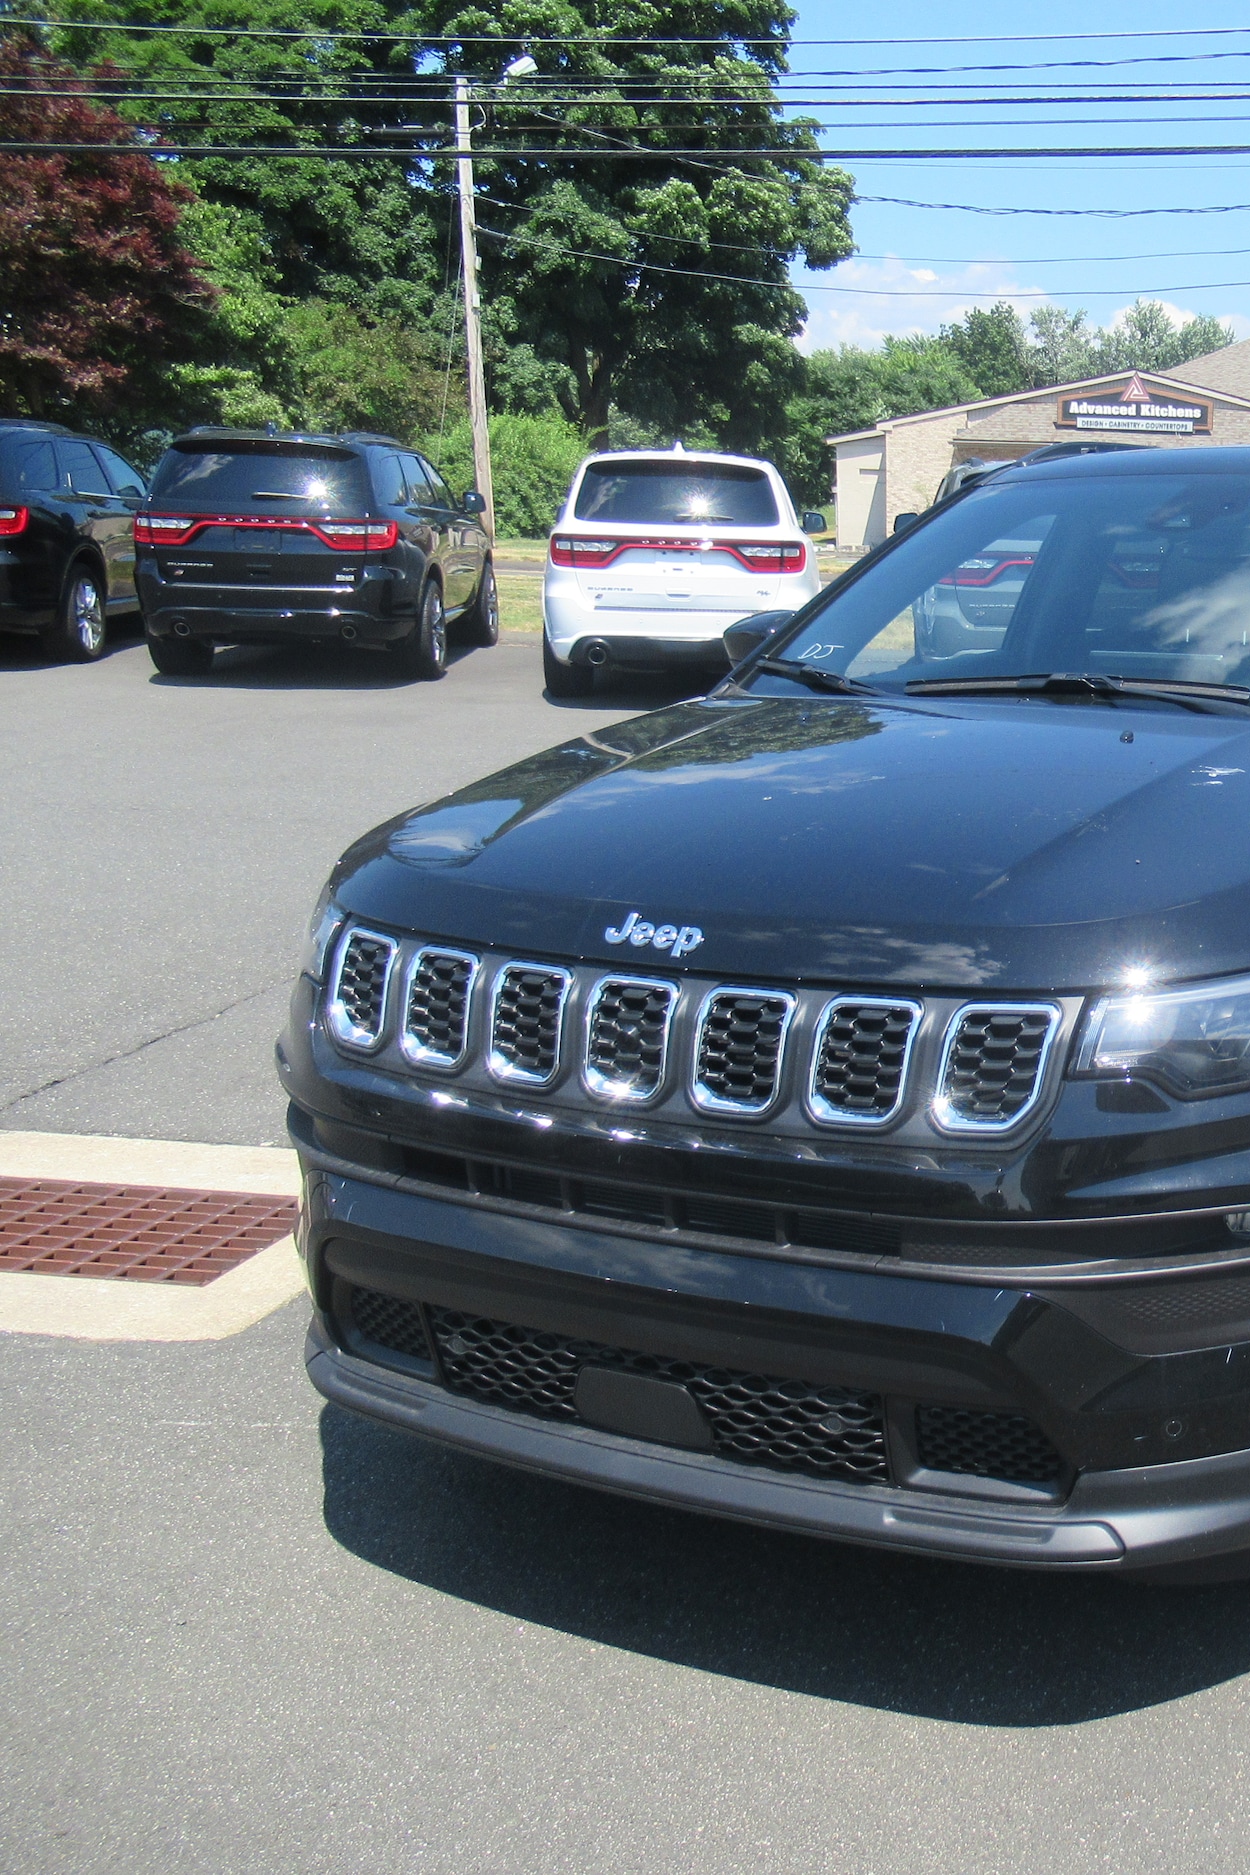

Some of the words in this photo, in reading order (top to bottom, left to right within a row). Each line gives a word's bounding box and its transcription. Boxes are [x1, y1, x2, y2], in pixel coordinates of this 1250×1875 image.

[1069, 401, 1137, 416] Advanced
[1140, 403, 1202, 419] Kitchens
[1081, 420, 1104, 428] DESIGN
[1108, 421, 1140, 429] CABINETRY
[1145, 423, 1188, 431] COUNTERTOPS
[604, 911, 704, 958] Jeep
